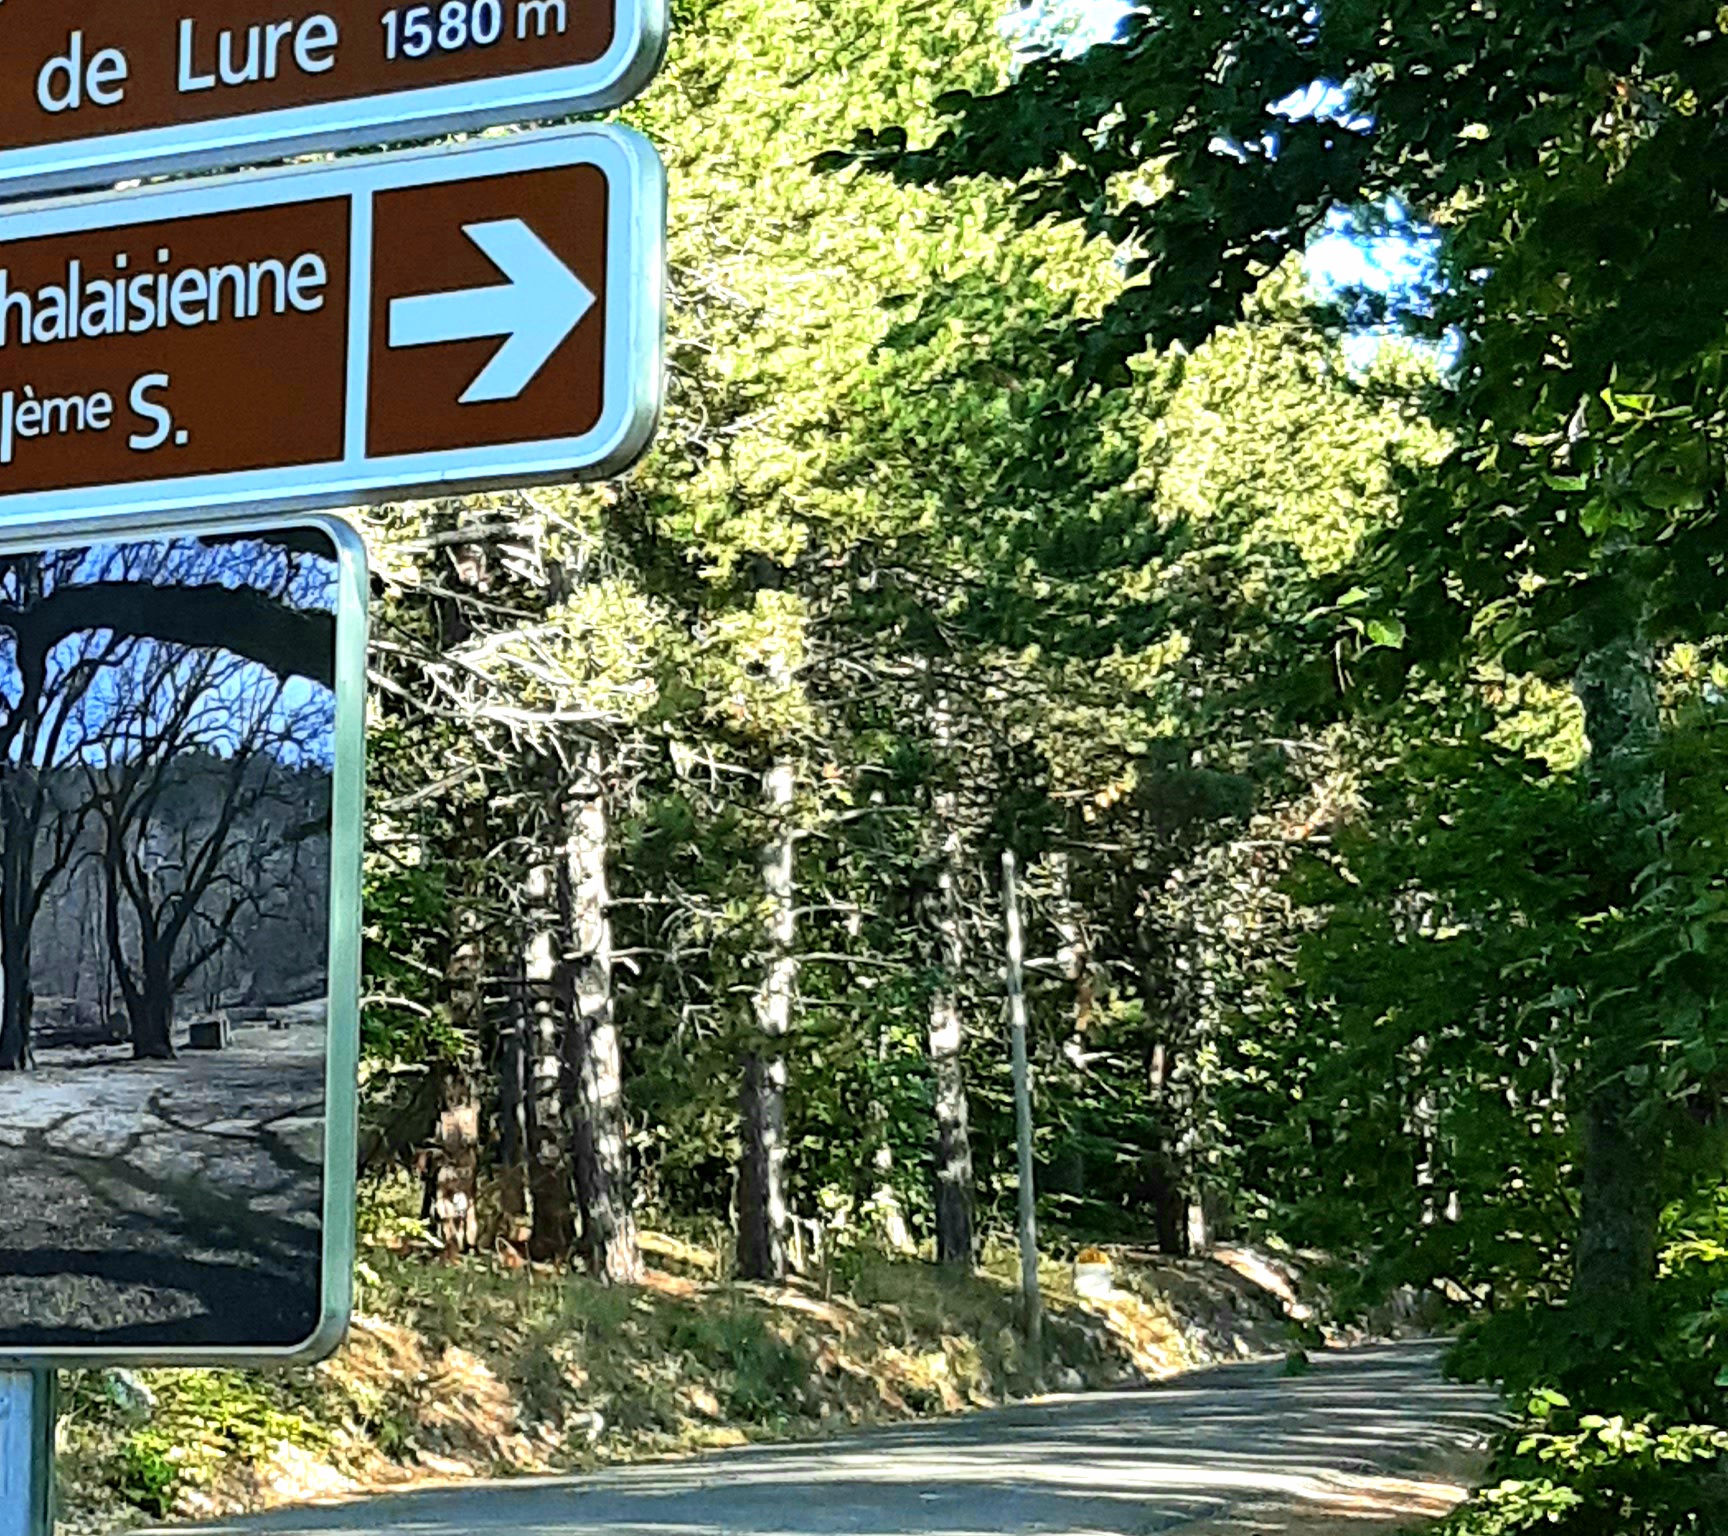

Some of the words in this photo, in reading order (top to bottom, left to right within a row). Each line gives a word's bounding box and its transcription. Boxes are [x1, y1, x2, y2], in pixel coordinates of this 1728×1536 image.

[36, 29, 128, 113] de
[177, 13, 339, 93] Lure
[128, 372, 189, 451] S.
